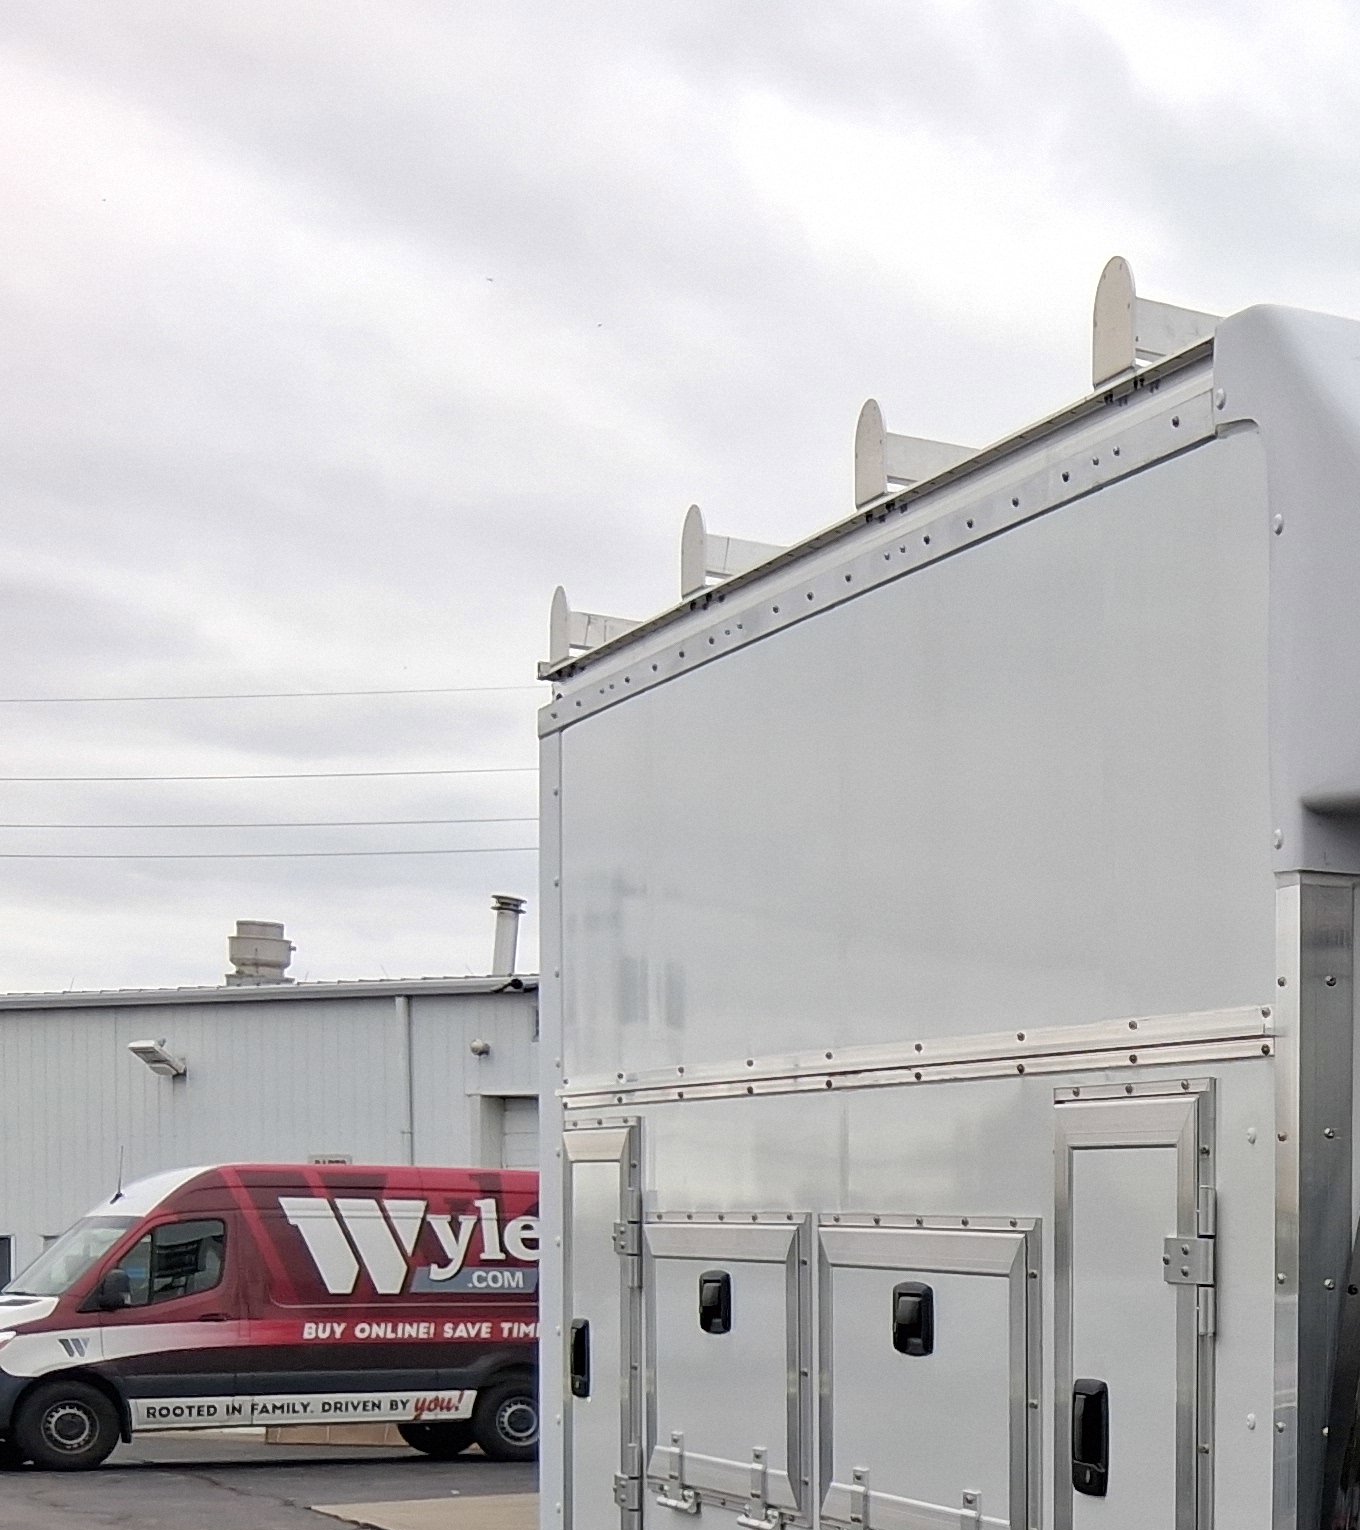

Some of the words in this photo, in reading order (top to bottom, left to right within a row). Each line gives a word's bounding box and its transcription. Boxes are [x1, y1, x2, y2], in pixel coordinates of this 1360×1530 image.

[467, 1270, 524, 1289] .COM
[302, 1322, 348, 1340] BUY
[354, 1322, 436, 1340] ONLINE!
[443, 1321, 493, 1339] SAVE
[146, 1404, 218, 1419] ROOTED
[225, 1403, 243, 1416] IN
[251, 1401, 315, 1417] FAMILY.
[321, 1399, 382, 1413] DRIVEN
[389, 1398, 410, 1411] BY
[413, 1390, 465, 1422] you!
